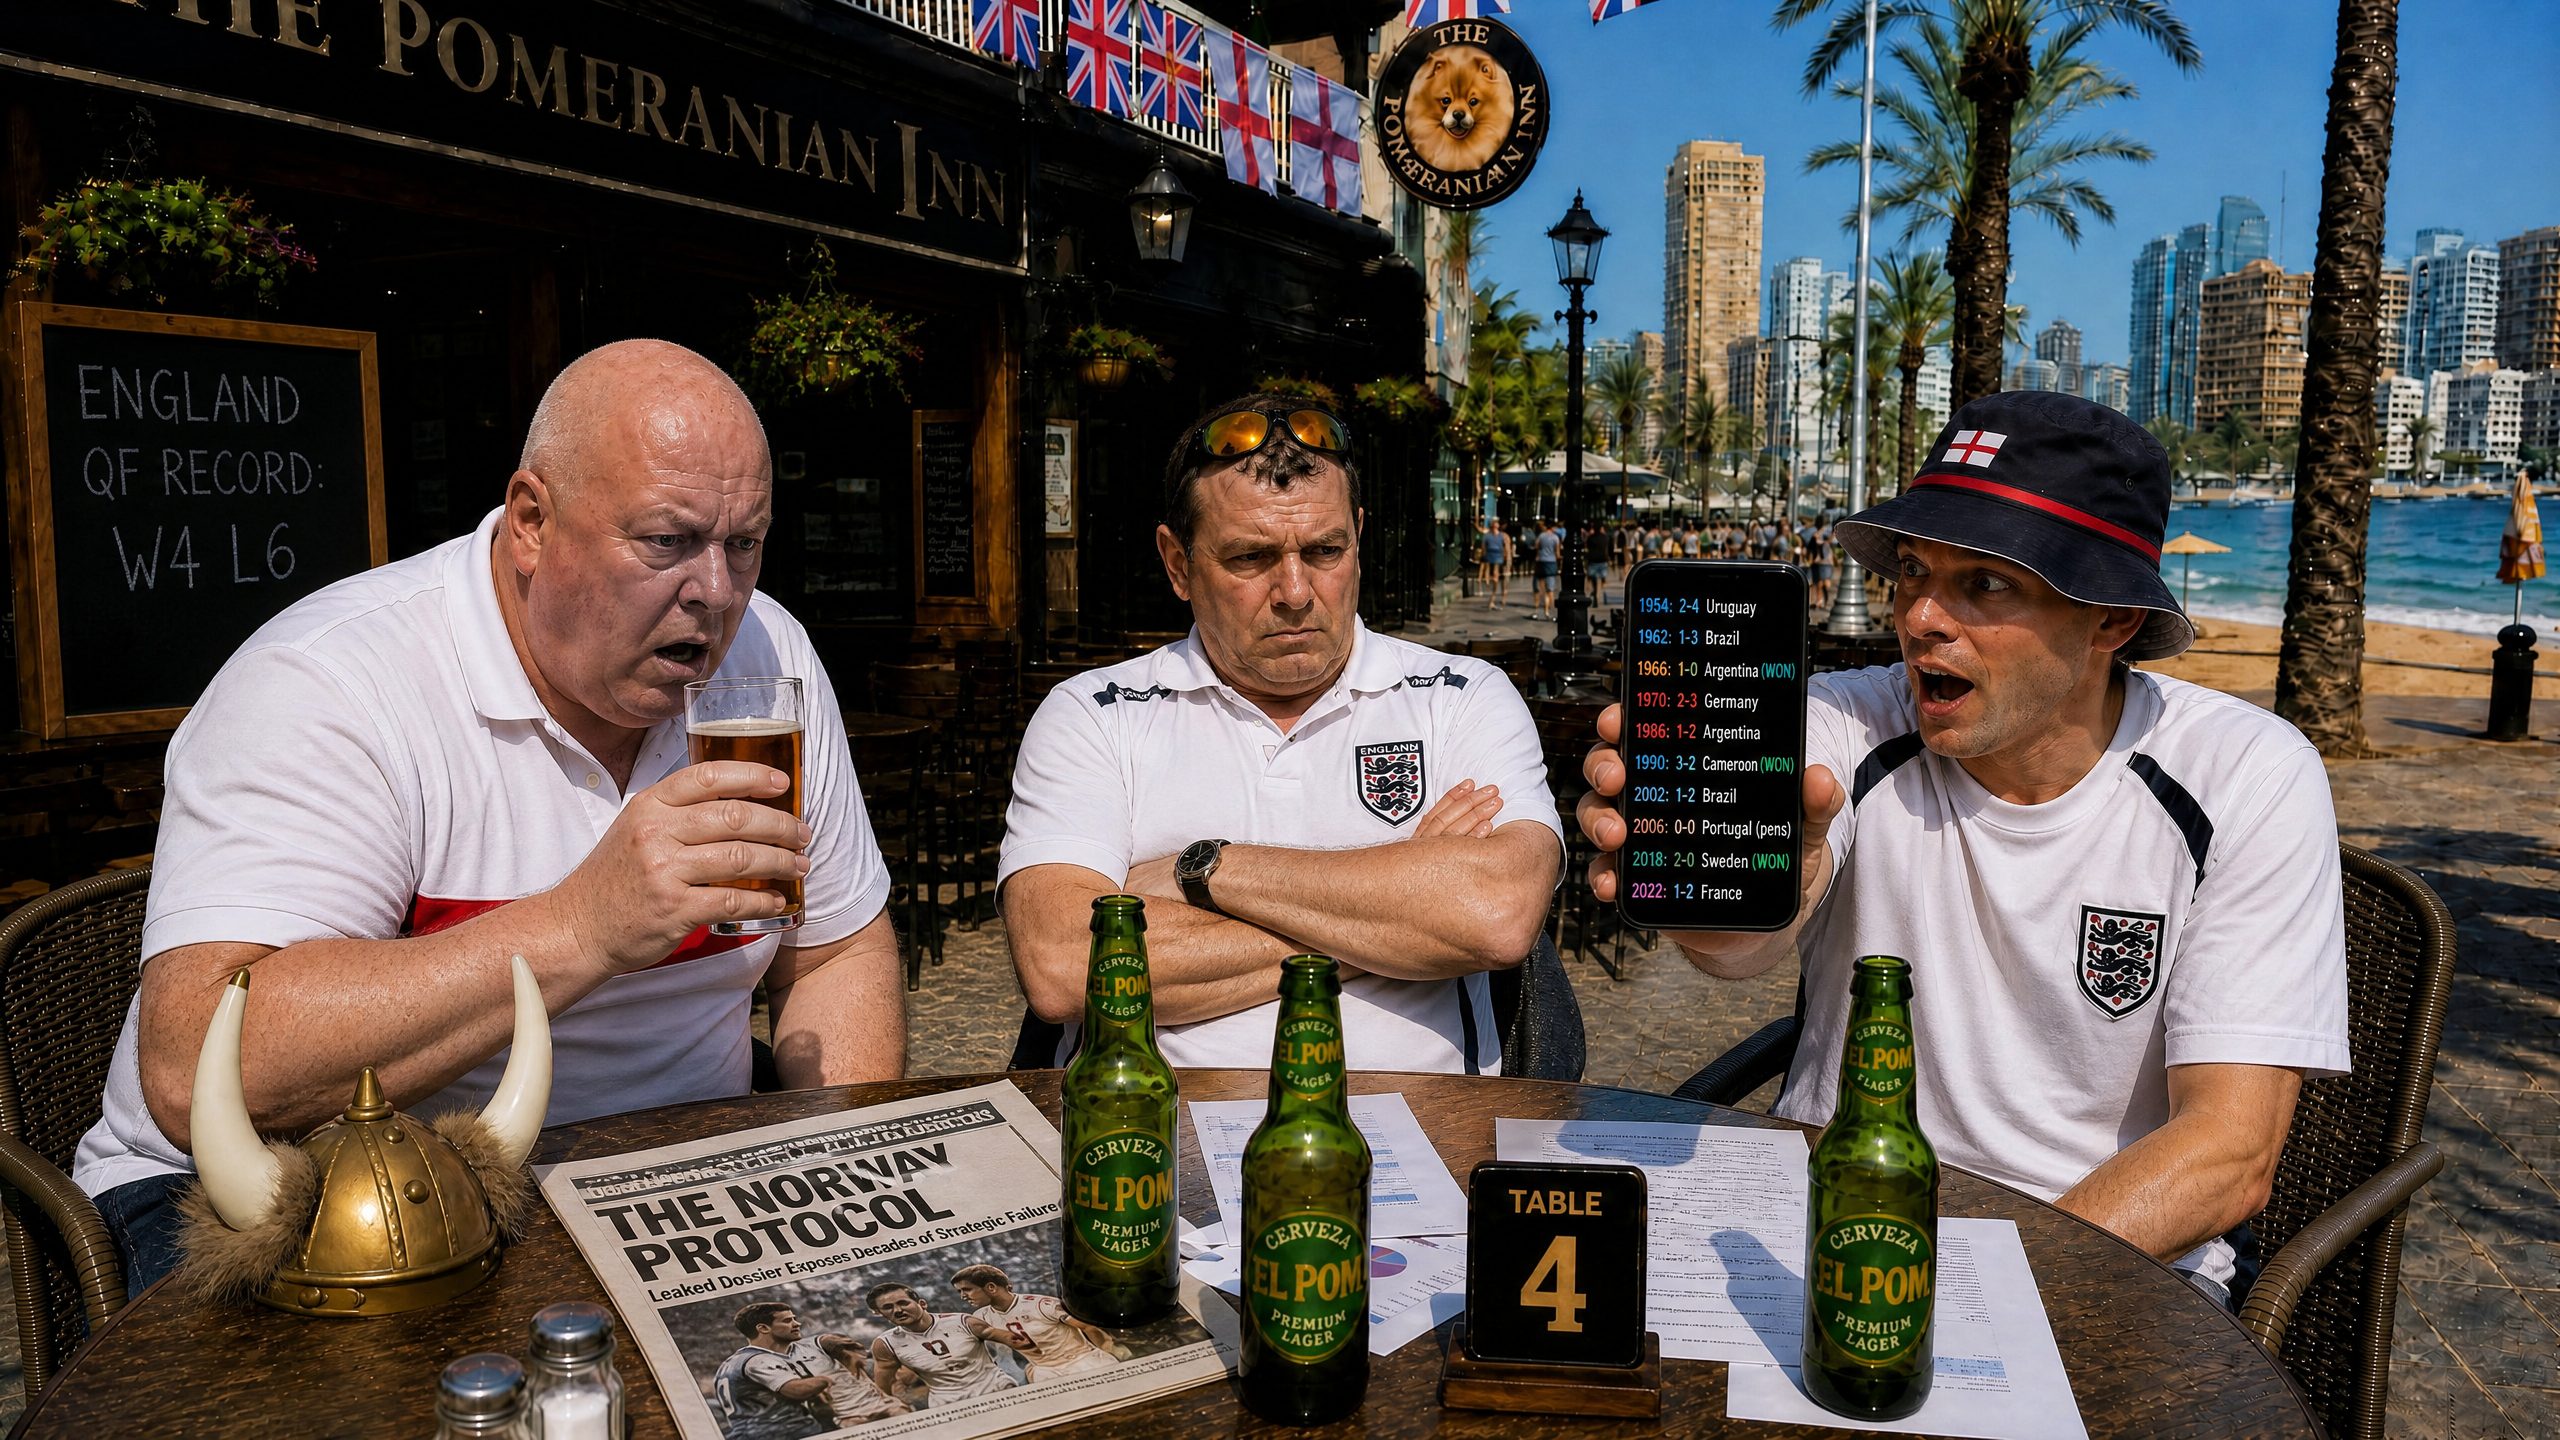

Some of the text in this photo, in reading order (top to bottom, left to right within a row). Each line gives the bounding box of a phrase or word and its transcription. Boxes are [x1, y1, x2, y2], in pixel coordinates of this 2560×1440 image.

[1434, 24, 1490, 46] THE
[379, 0, 1006, 226] POMERANIAN INN
[1516, 84, 1537, 140] INN
[80, 364, 300, 425] ENGLAND
[83, 446, 324, 500] QF RECORD:
[112, 522, 296, 592] W4 L6
[1639, 597, 1757, 618] 1954: 2-4 Uruguay
[1638, 629, 1740, 646] 1962: 1-3 Brazil
[1637, 660, 1796, 681] 1966: 1-0 Argentina (WON)
[1637, 691, 1759, 713] 1970: 2-3 Germany
[1636, 723, 1761, 743] 1986: 1-2 Argentina
[1635, 754, 1794, 775] 1990: 3-2 Cameroon (WON)
[1634, 786, 1737, 804] 2002: 1-2 Brazil
[1633, 818, 1792, 839] 2006: 0-0 Portugal (pens)
[1632, 851, 1790, 872] 2018: 2-0 Sweden (WON)
[1632, 883, 1743, 900] 2022: 1-2 France
[1098, 956, 1145, 973] CERVEZA
[1092, 972, 1150, 997] EL POM
[1284, 1021, 1335, 1038] CERVEZA
[1855, 1025, 1906, 1043] CERVEZA
[1279, 1039, 1342, 1065] EL POM
[1847, 1043, 1913, 1071] EL POM
[1085, 1138, 1163, 1166] CERVEZA
[594, 1191, 727, 1241] THE
[725, 1142, 953, 1219] NORWAY
[1075, 1167, 1175, 1212] EL POM
[1508, 1189, 1602, 1216] TABLE
[623, 1188, 955, 1283] PROTOCOL
[1092, 1218, 1161, 1237] PREMIUM
[1265, 1221, 1352, 1250] CERVEZA
[1830, 1223, 1918, 1255] CERVEZA
[1101, 1236, 1151, 1253] LAGER
[648, 1278, 717, 1303] Leaked
[717, 1266, 783, 1290] Dossier
[850, 1236, 917, 1261] Decades
[918, 1230, 936, 1245] of
[1252, 1254, 1288, 1300] EL
[1294, 1254, 1363, 1302] POM
[1816, 1252, 1853, 1301] EL
[1859, 1259, 1930, 1306] POM
[1520, 1235, 1587, 1333] 4
[1271, 1308, 1346, 1330] PREMIUM
[1835, 1310, 1912, 1335] PREMIUM
[1281, 1330, 1334, 1347] LAGER
[1845, 1333, 1900, 1352] LAGER
